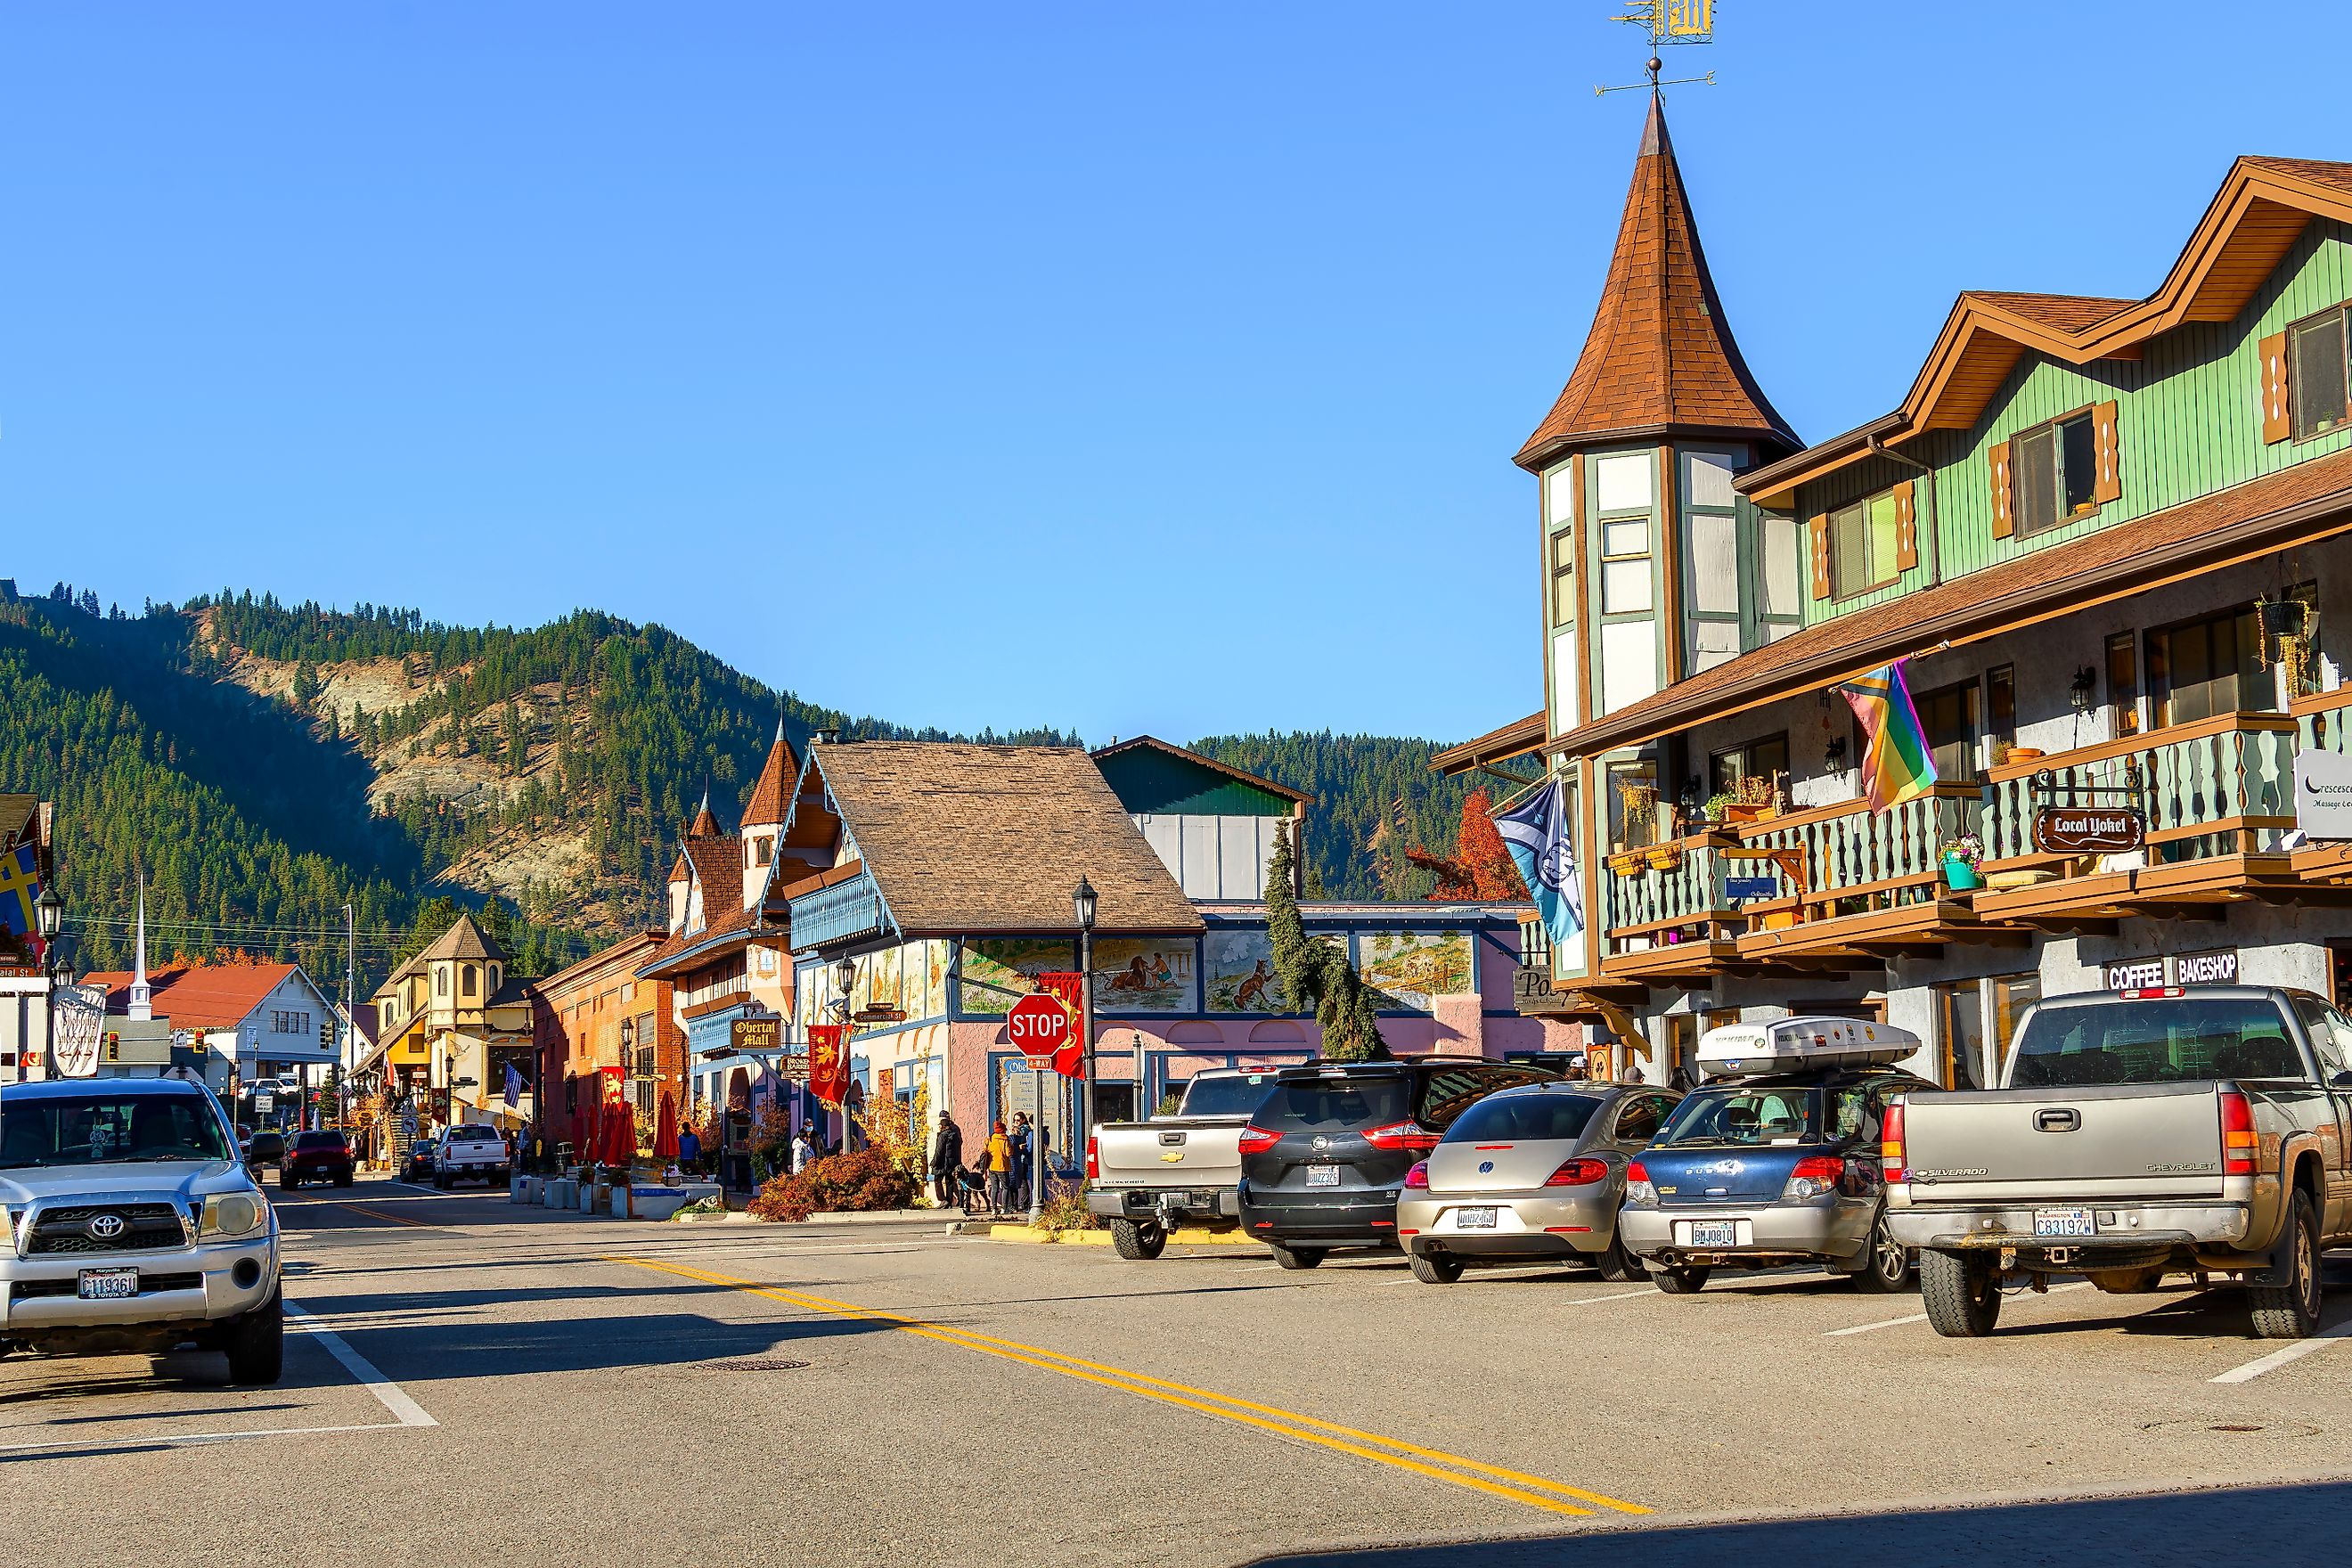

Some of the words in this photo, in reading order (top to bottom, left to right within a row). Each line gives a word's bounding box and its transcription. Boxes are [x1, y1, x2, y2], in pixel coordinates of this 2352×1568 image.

[2313, 799, 2340, 810] Massage
[2054, 817, 2087, 832] Local
[2089, 817, 2127, 836] Yokel
[20, 968, 29, 976] St
[2109, 962, 2163, 989] COFFEE
[2178, 954, 2236, 984] BAKESHOP
[735, 1021, 776, 1033] Obertal
[1012, 1014, 1065, 1037] STOP
[741, 1034, 769, 1047] Mall
[1028, 1059, 1049, 1067] 4-WAY
[1927, 1168, 1988, 1176] SILVERADO
[2145, 1163, 2215, 1172] CHEVROLET
[2037, 1220, 2091, 1235] C83192W
[1695, 1229, 1733, 1242] BMJ0810
[82, 1278, 135, 1294] C11936U
